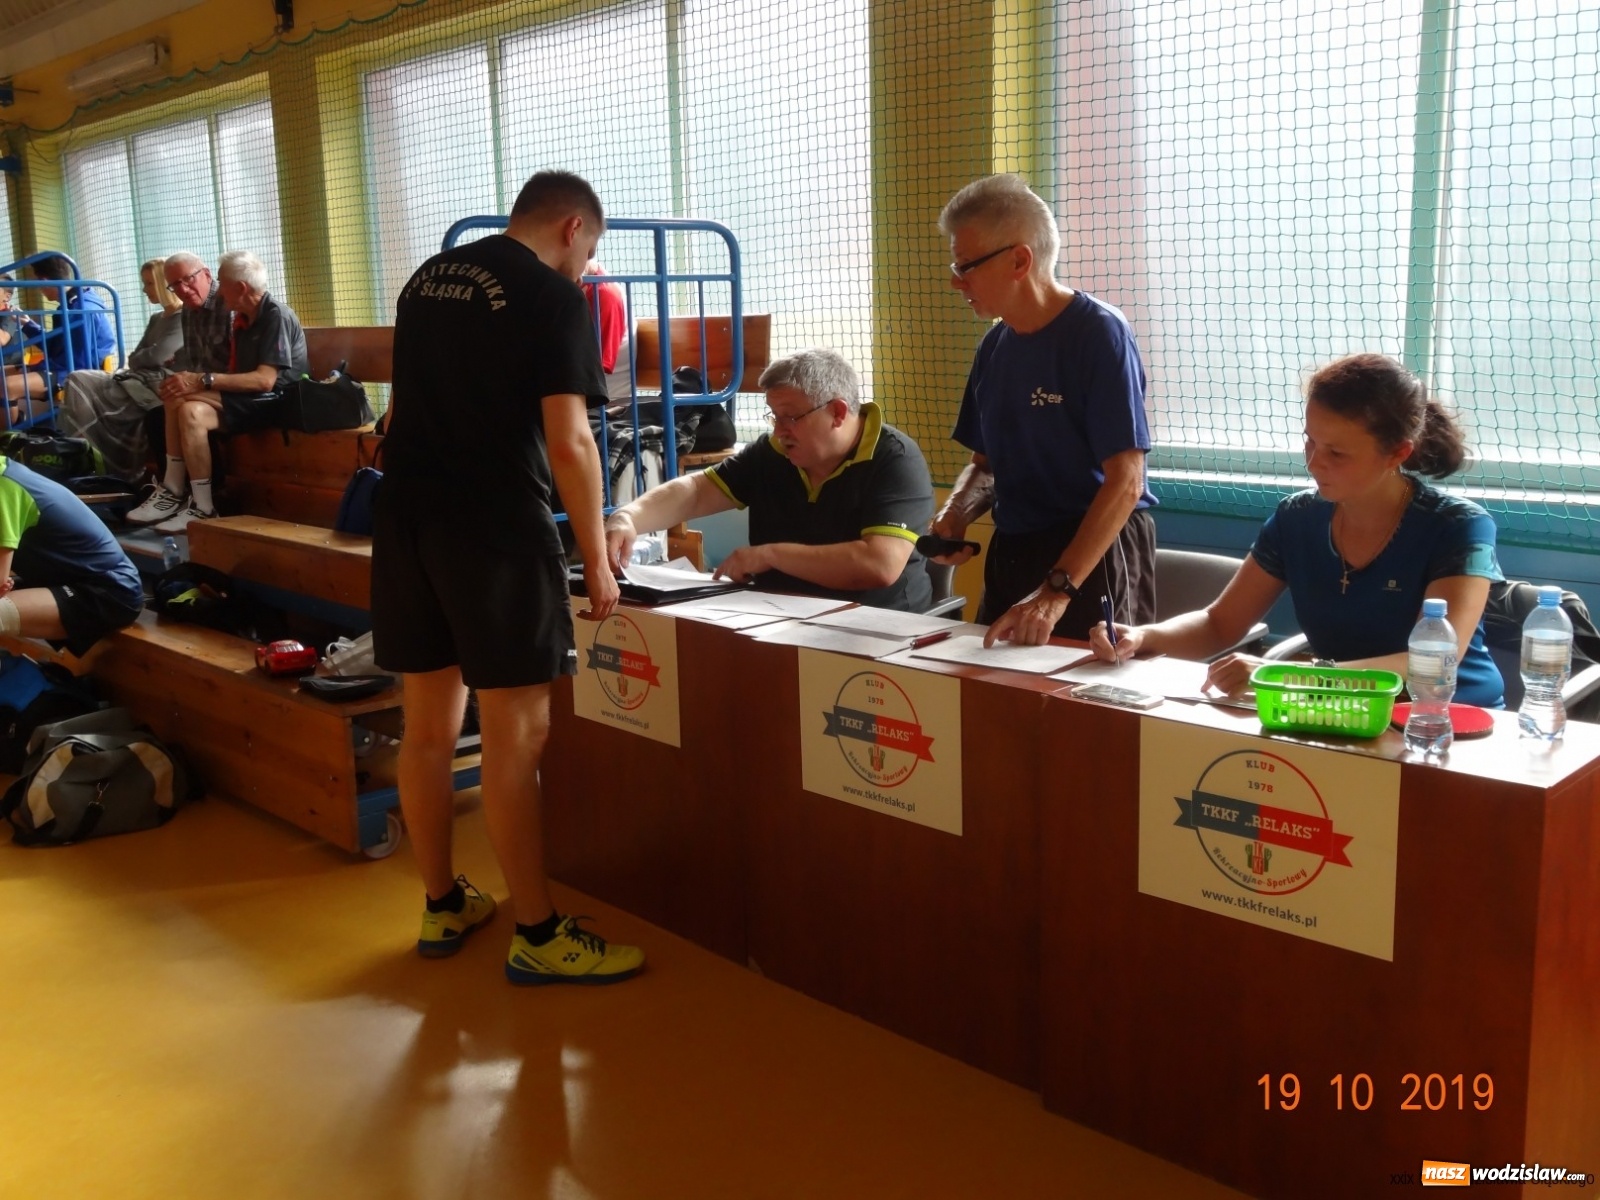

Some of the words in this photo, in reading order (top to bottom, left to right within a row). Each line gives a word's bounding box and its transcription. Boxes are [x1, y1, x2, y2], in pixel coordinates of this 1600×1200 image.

[421, 279, 474, 301] ŚLĄSKA
[865, 679, 885, 689] KLUB
[868, 696, 884, 706] 1978
[839, 715, 864, 731] TKKF
[1245, 759, 1276, 773] KLUB
[1247, 780, 1274, 793] 1978
[842, 785, 916, 812] www.tkkfrelaks.pl
[1201, 803, 1240, 823] TKKF
[1201, 889, 1318, 928] www.tkkfrelaks.pl
